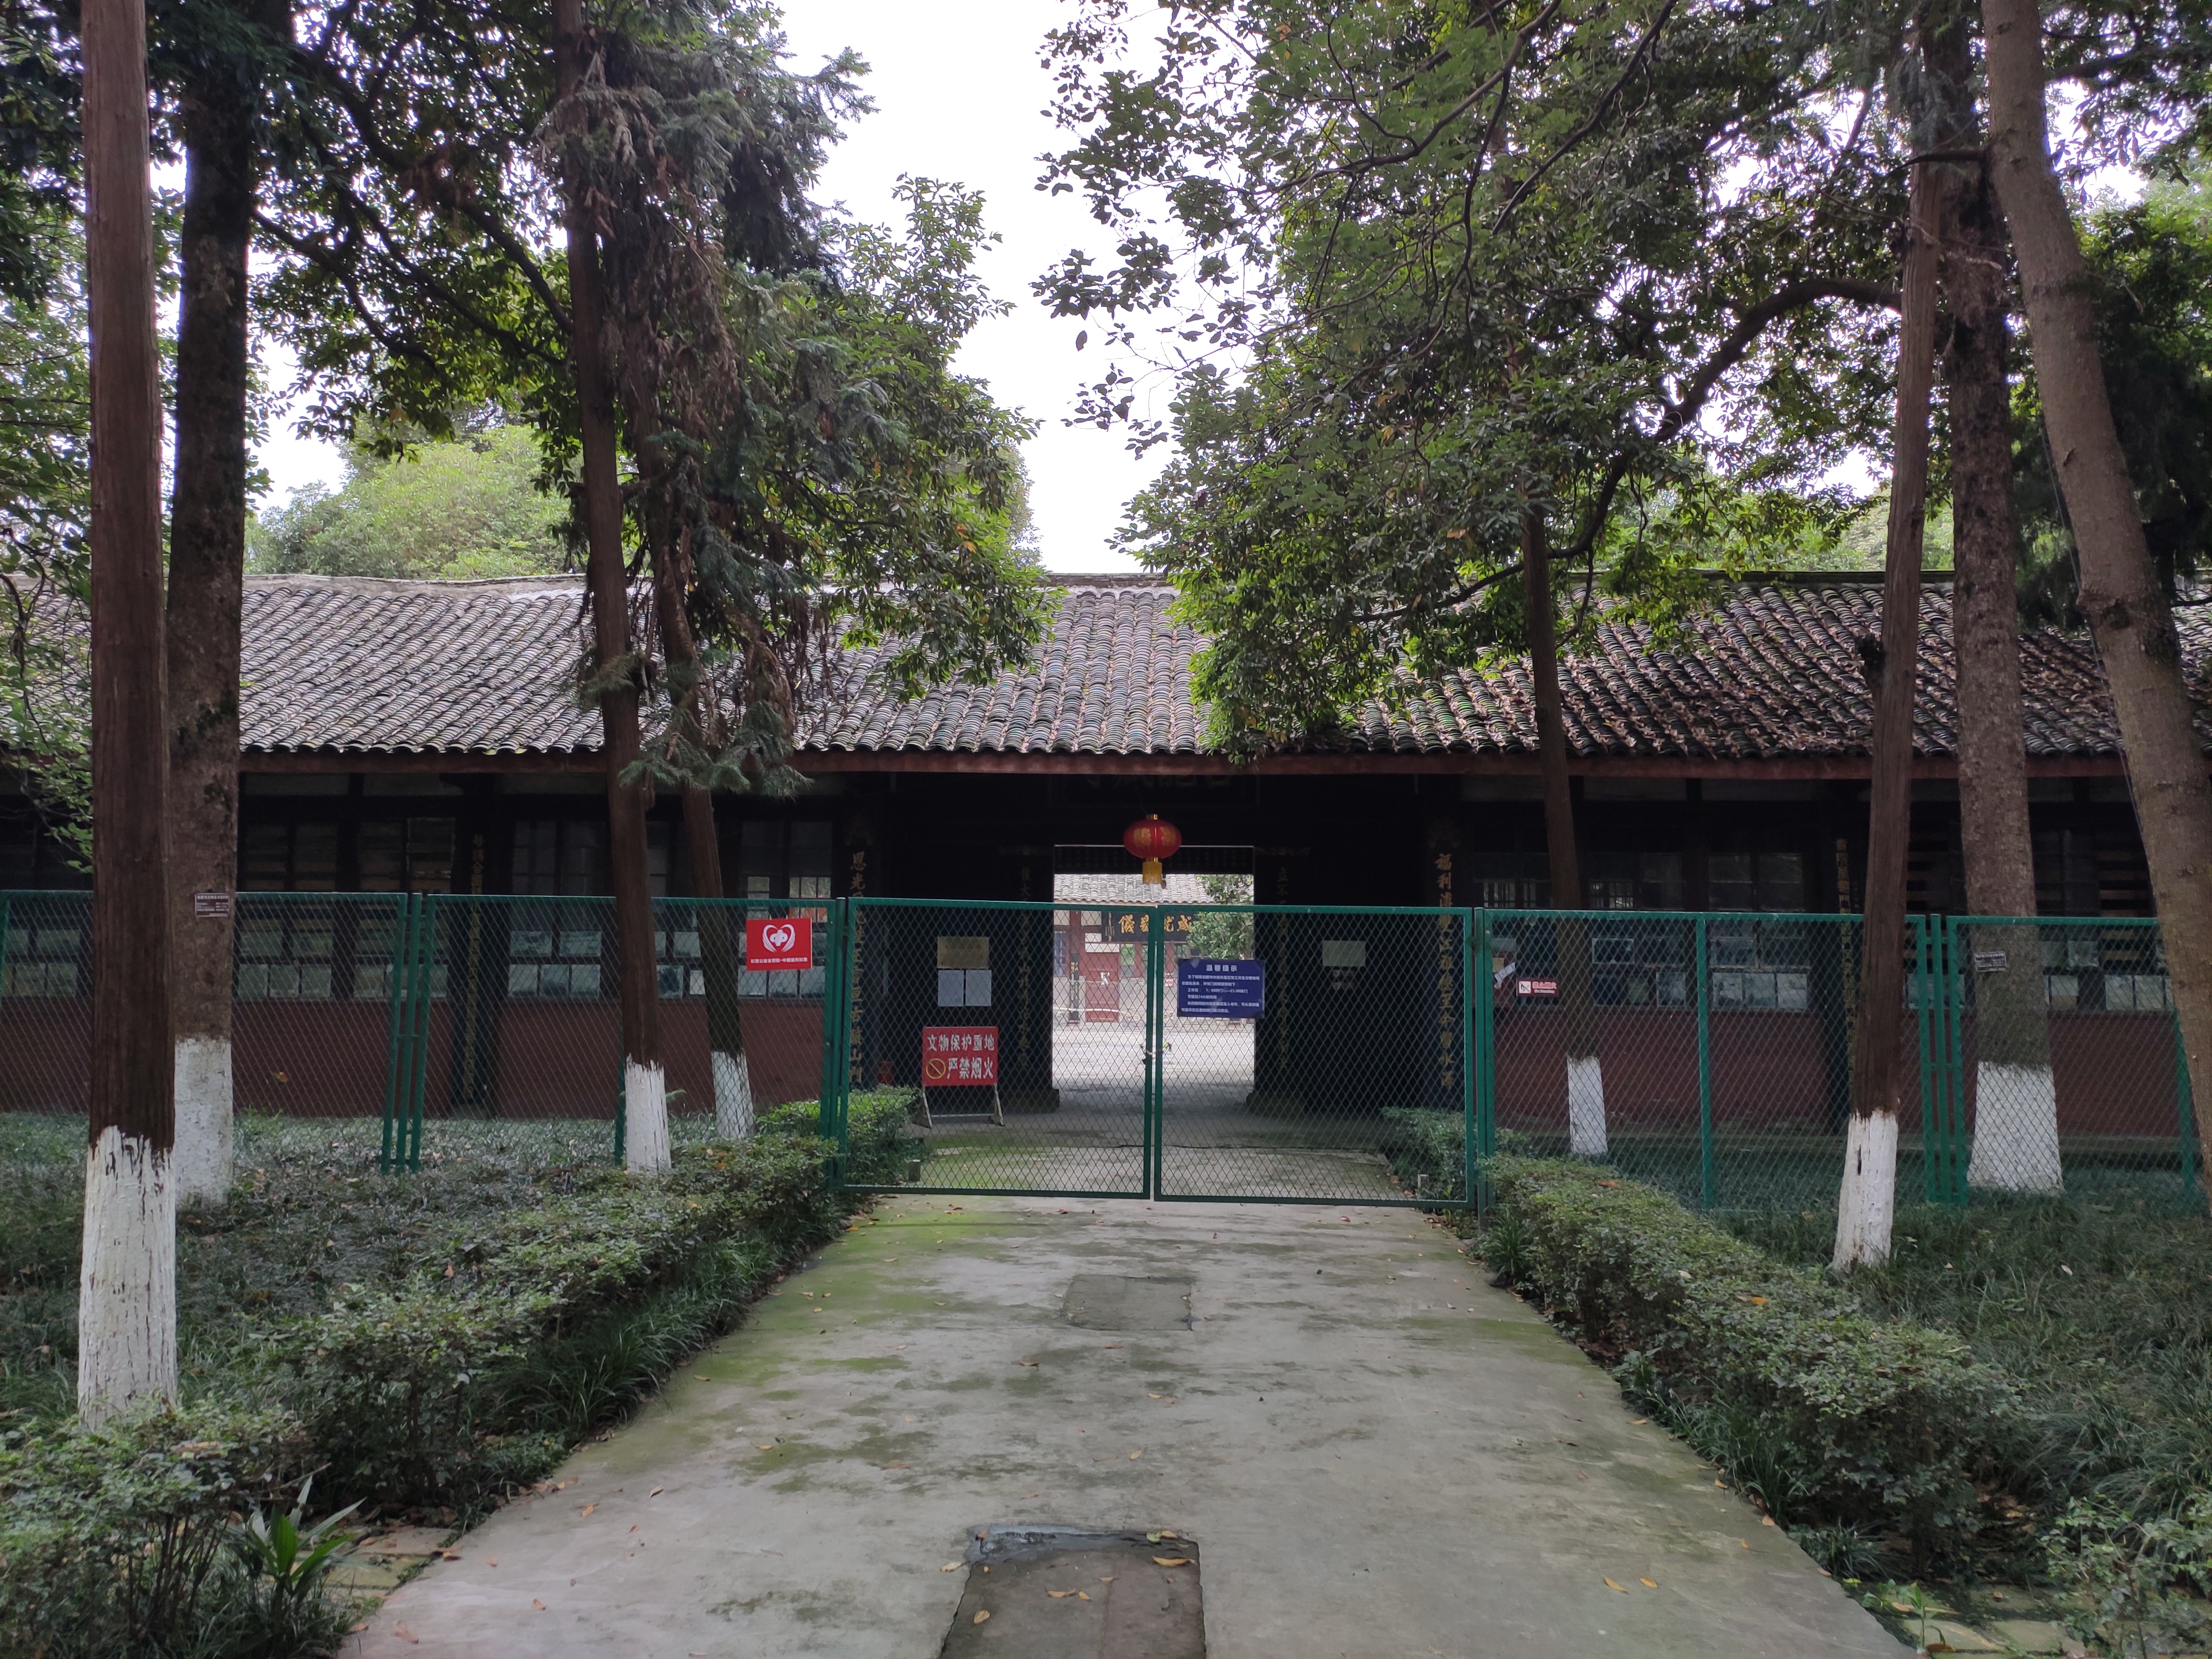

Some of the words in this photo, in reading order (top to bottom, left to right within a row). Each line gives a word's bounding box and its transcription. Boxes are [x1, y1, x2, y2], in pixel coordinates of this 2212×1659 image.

[927, 1034, 995, 1052] 文物保护重地
[947, 1056, 994, 1079] 严禁烟火
